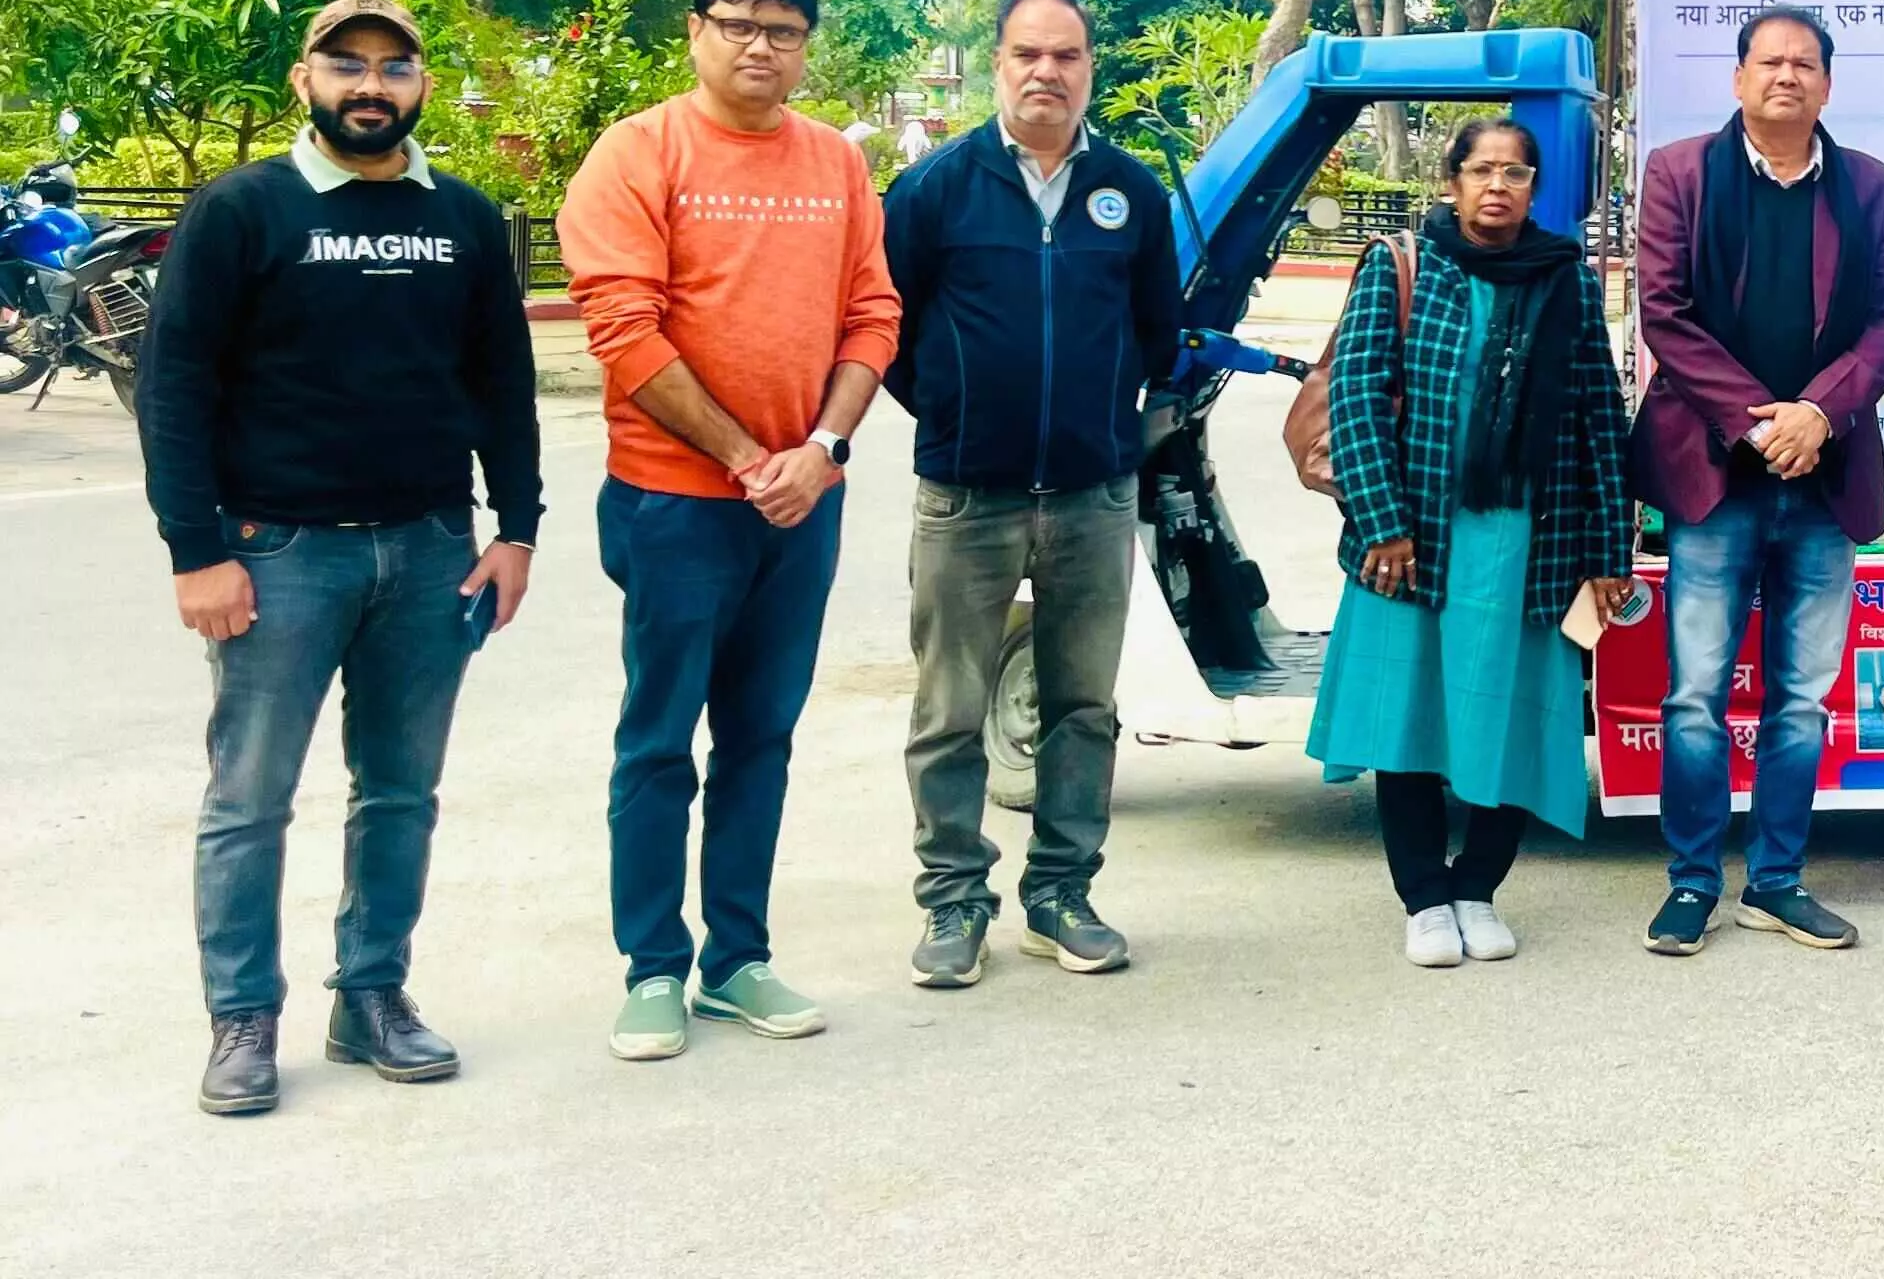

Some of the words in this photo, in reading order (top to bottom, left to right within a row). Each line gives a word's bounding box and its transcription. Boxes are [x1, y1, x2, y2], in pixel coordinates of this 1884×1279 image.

[1676, 5, 1710, 25] नया
[1836, 5, 1867, 27] एक
[310, 234, 456, 264] IMAGINE
